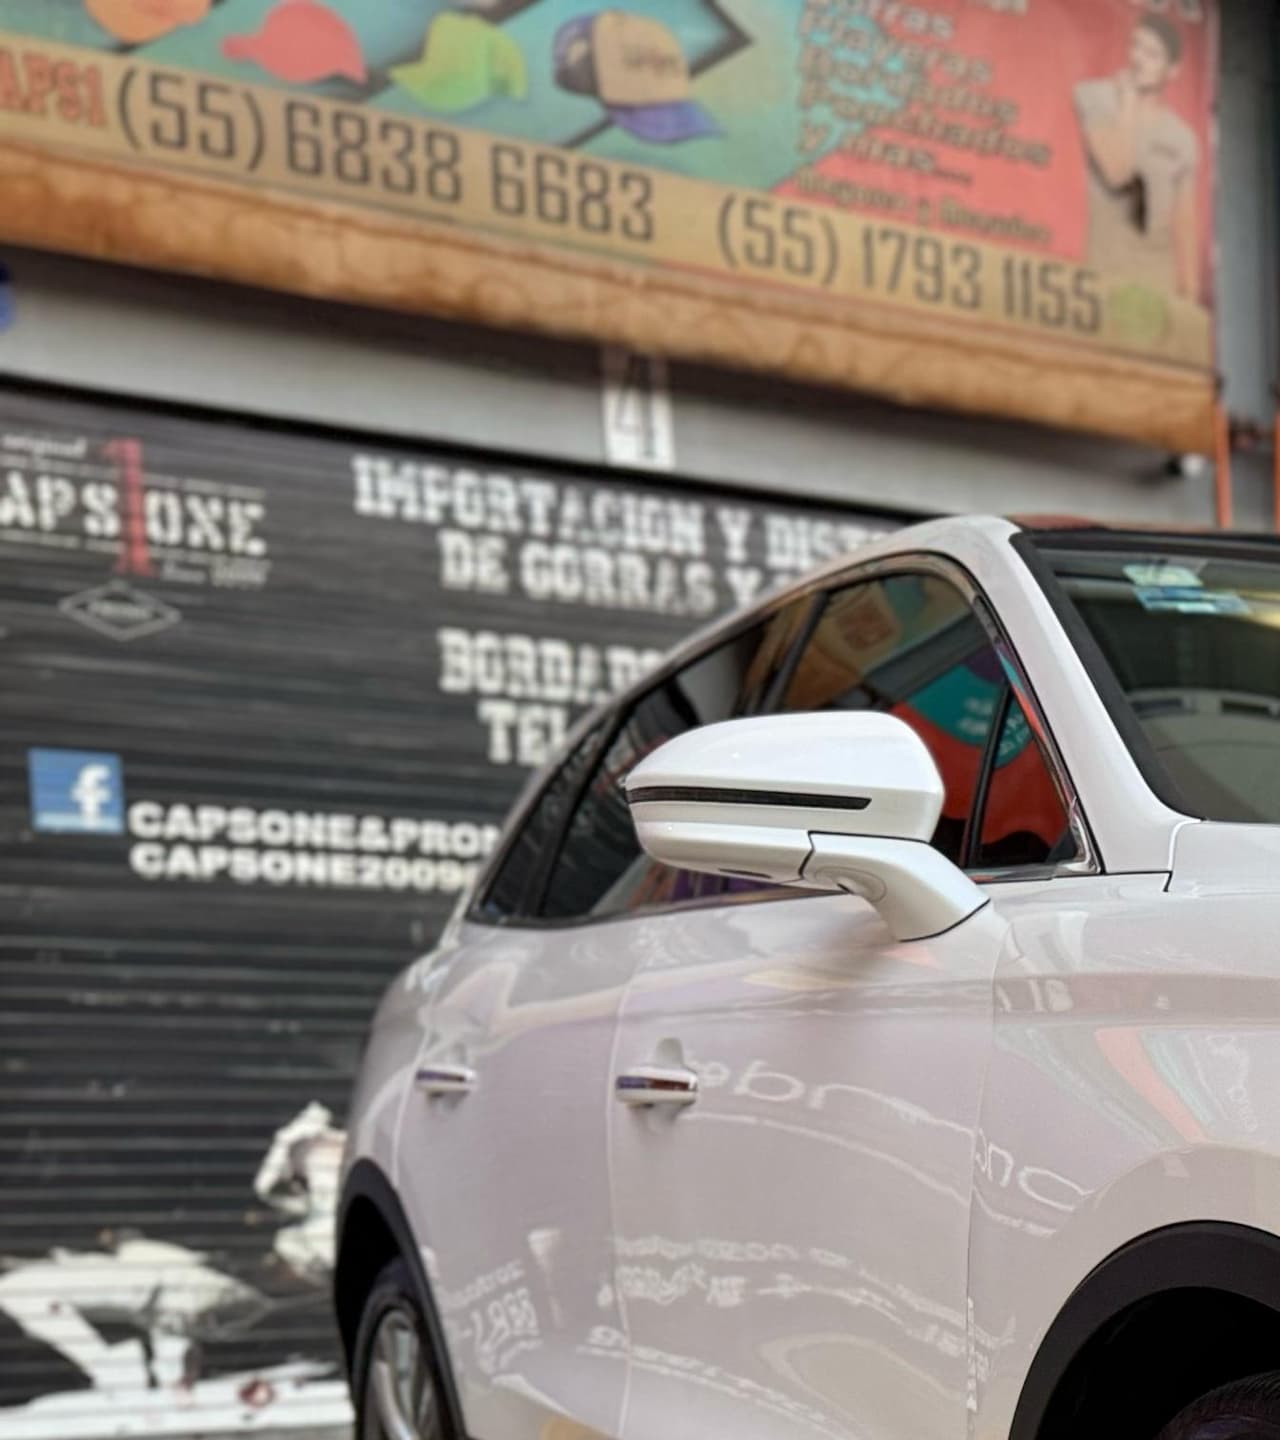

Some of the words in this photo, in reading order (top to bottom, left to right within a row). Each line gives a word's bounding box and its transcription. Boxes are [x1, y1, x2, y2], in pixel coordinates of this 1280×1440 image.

[117, 67, 266, 172] (55)
[286, 102, 462, 203] 6838
[490, 143, 653, 242] 6683
[717, 192, 839, 286] (55)
[862, 226, 984, 311] 1793
[1003, 255, 1101, 335] 1155
[437, 528, 509, 595] DE
[717, 506, 752, 562] Y
